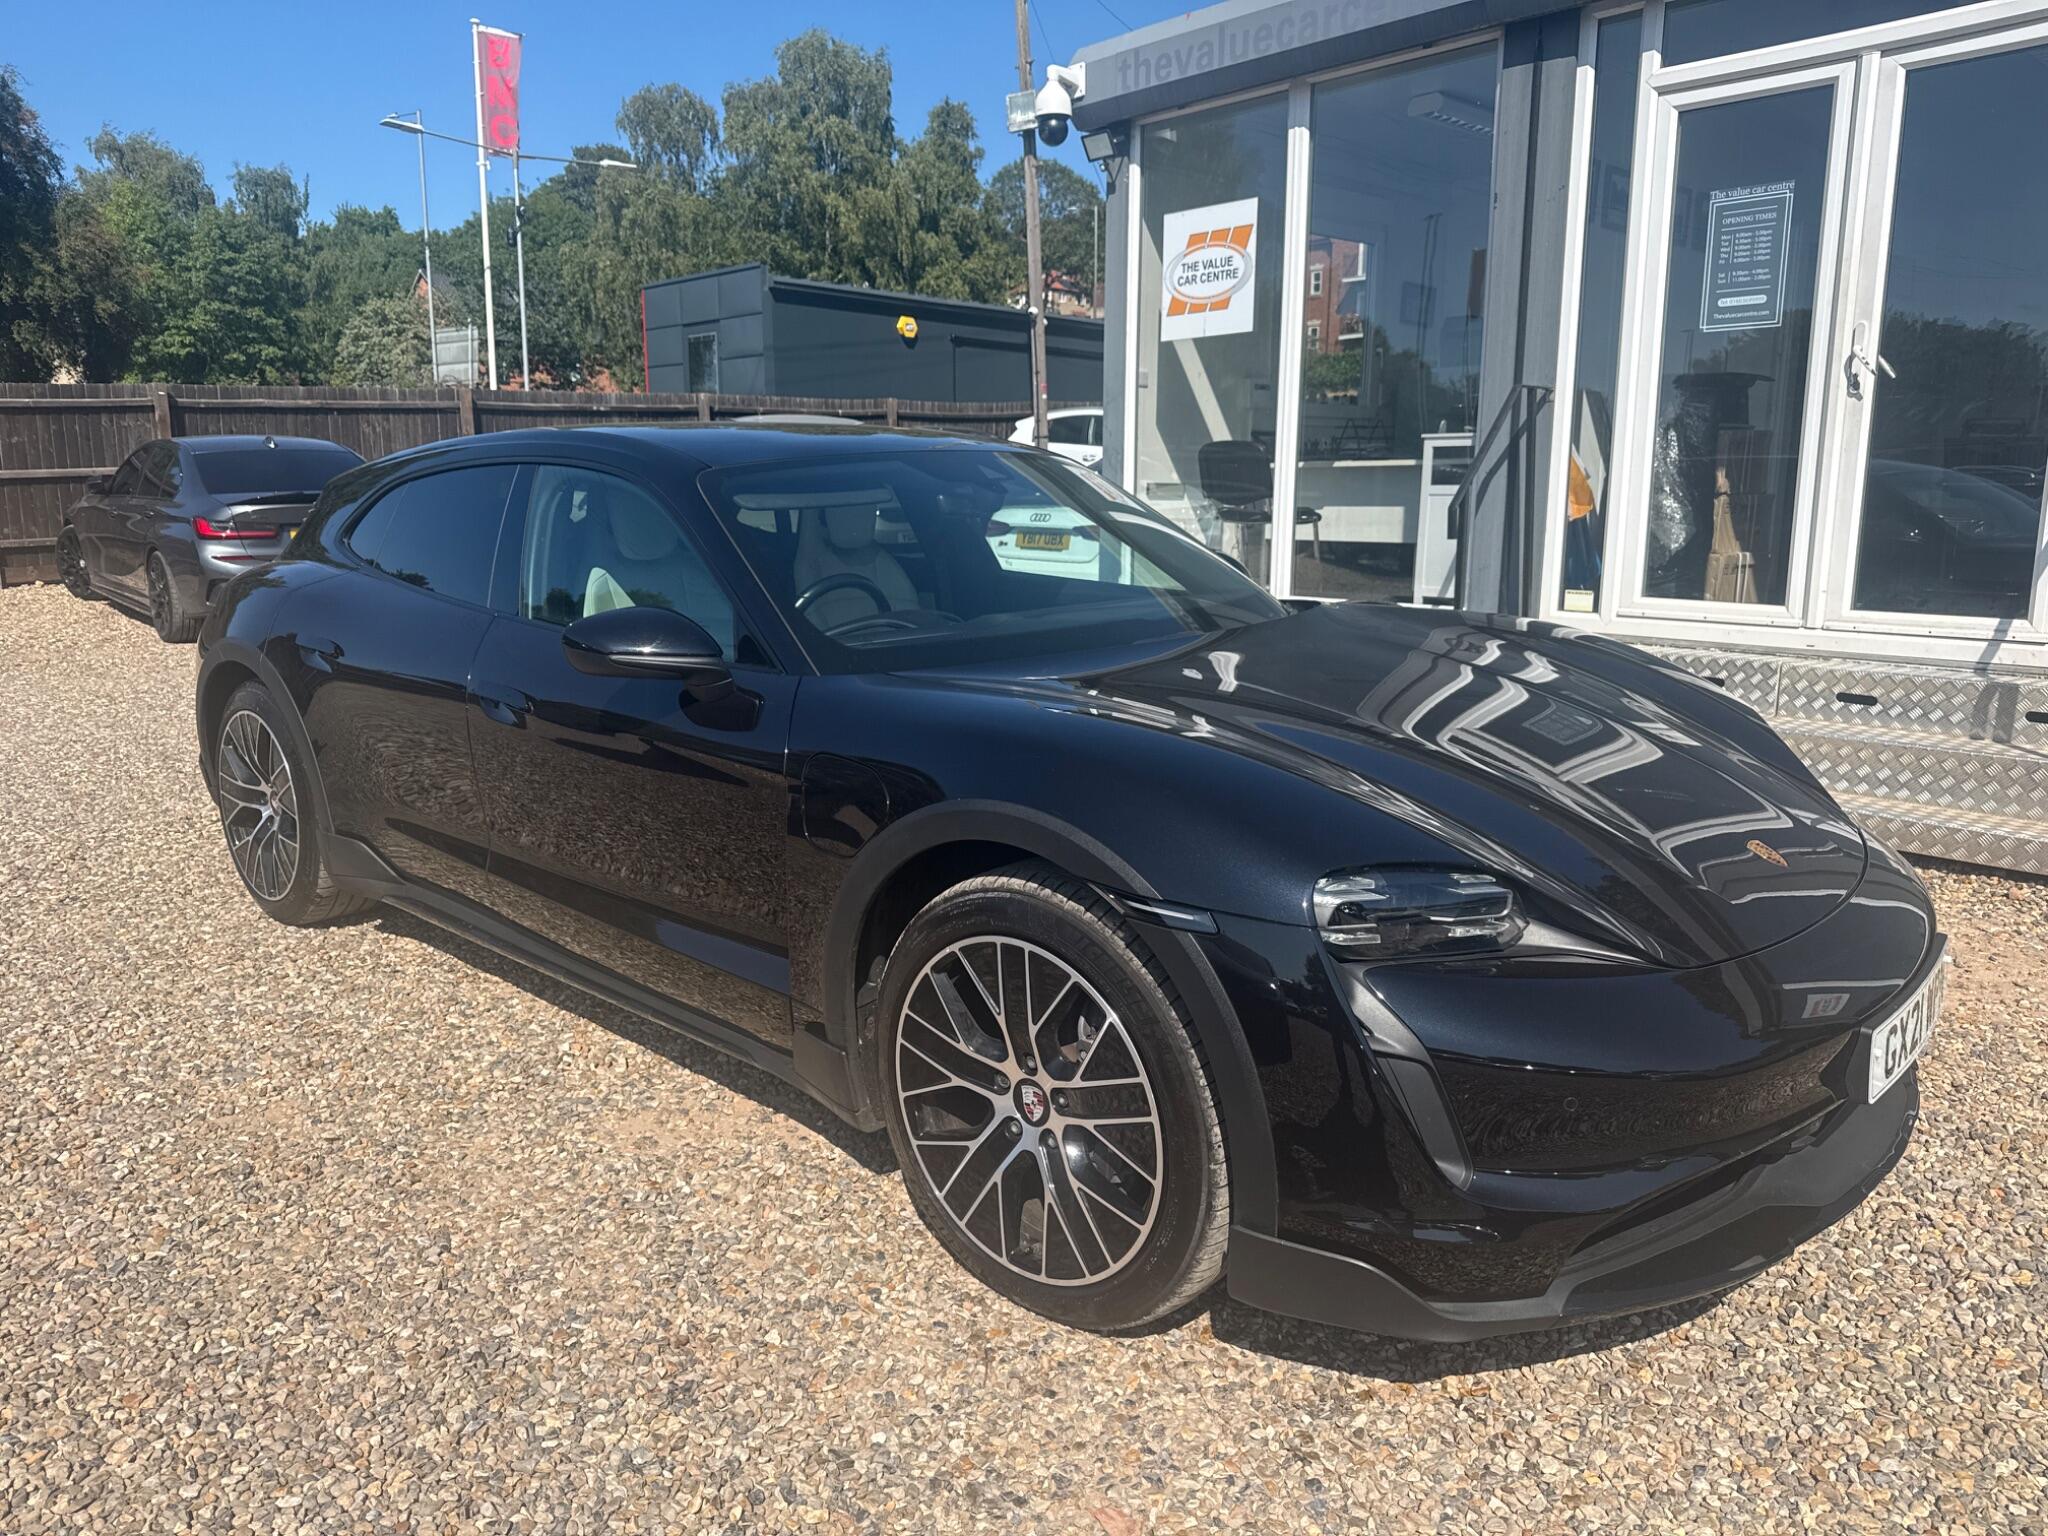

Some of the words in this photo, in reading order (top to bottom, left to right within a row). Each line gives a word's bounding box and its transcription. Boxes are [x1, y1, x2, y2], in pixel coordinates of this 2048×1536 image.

[1710, 191, 1727, 200] The
[1728, 187, 1750, 198] value
[1752, 185, 1766, 194] car
[1767, 181, 1795, 192] centre
[1722, 215, 1754, 225] OPENING
[1755, 212, 1777, 221] TIMES
[1181, 261, 1200, 274] THE
[1202, 256, 1234, 270] VALUE
[1177, 274, 1197, 287] CAR
[1200, 268, 1239, 284] CENTRE
[1885, 993, 1925, 1079] GX21
